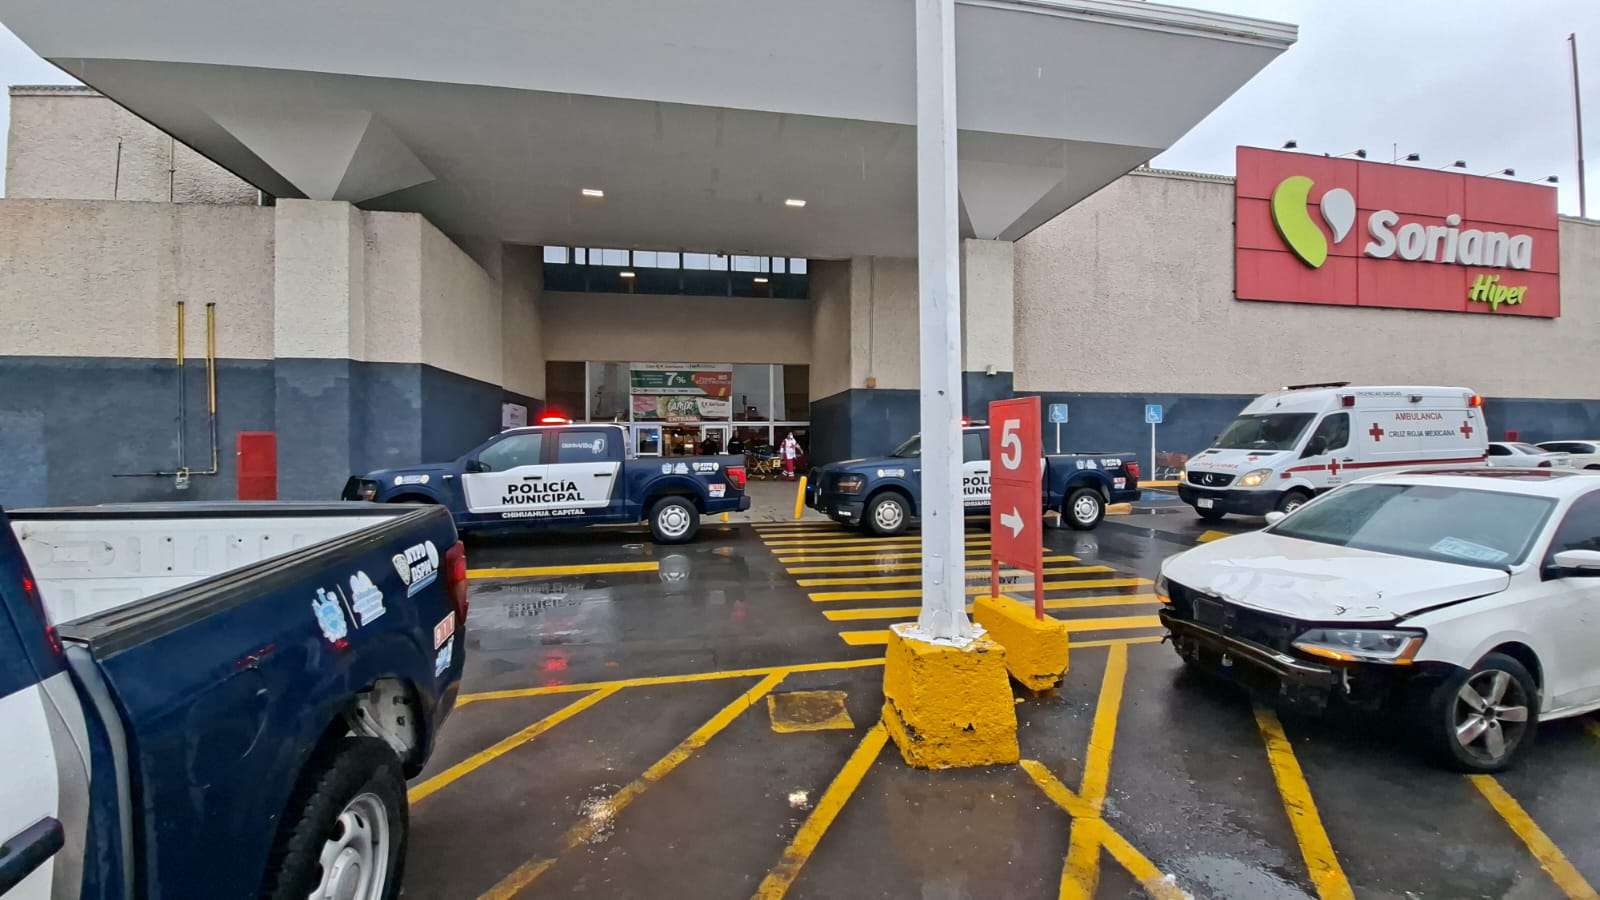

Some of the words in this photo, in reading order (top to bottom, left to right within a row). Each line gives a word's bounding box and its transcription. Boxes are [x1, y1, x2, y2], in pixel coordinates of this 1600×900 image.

[1364, 210, 1533, 270] Soriana
[1469, 274, 1527, 311] Hiper
[1395, 412, 1442, 421] AMBULANCIA
[1388, 430, 1405, 438] CRUZ
[1425, 429, 1455, 437] MEXICANA
[1000, 419, 1022, 470] 5
[508, 479, 578, 494] POLICÍA
[963, 476, 992, 486] POLI
[502, 492, 585, 504] MUNICIPAL
[502, 509, 550, 518] CHIHUAHUA
[552, 508, 585, 516] CAPITAL
